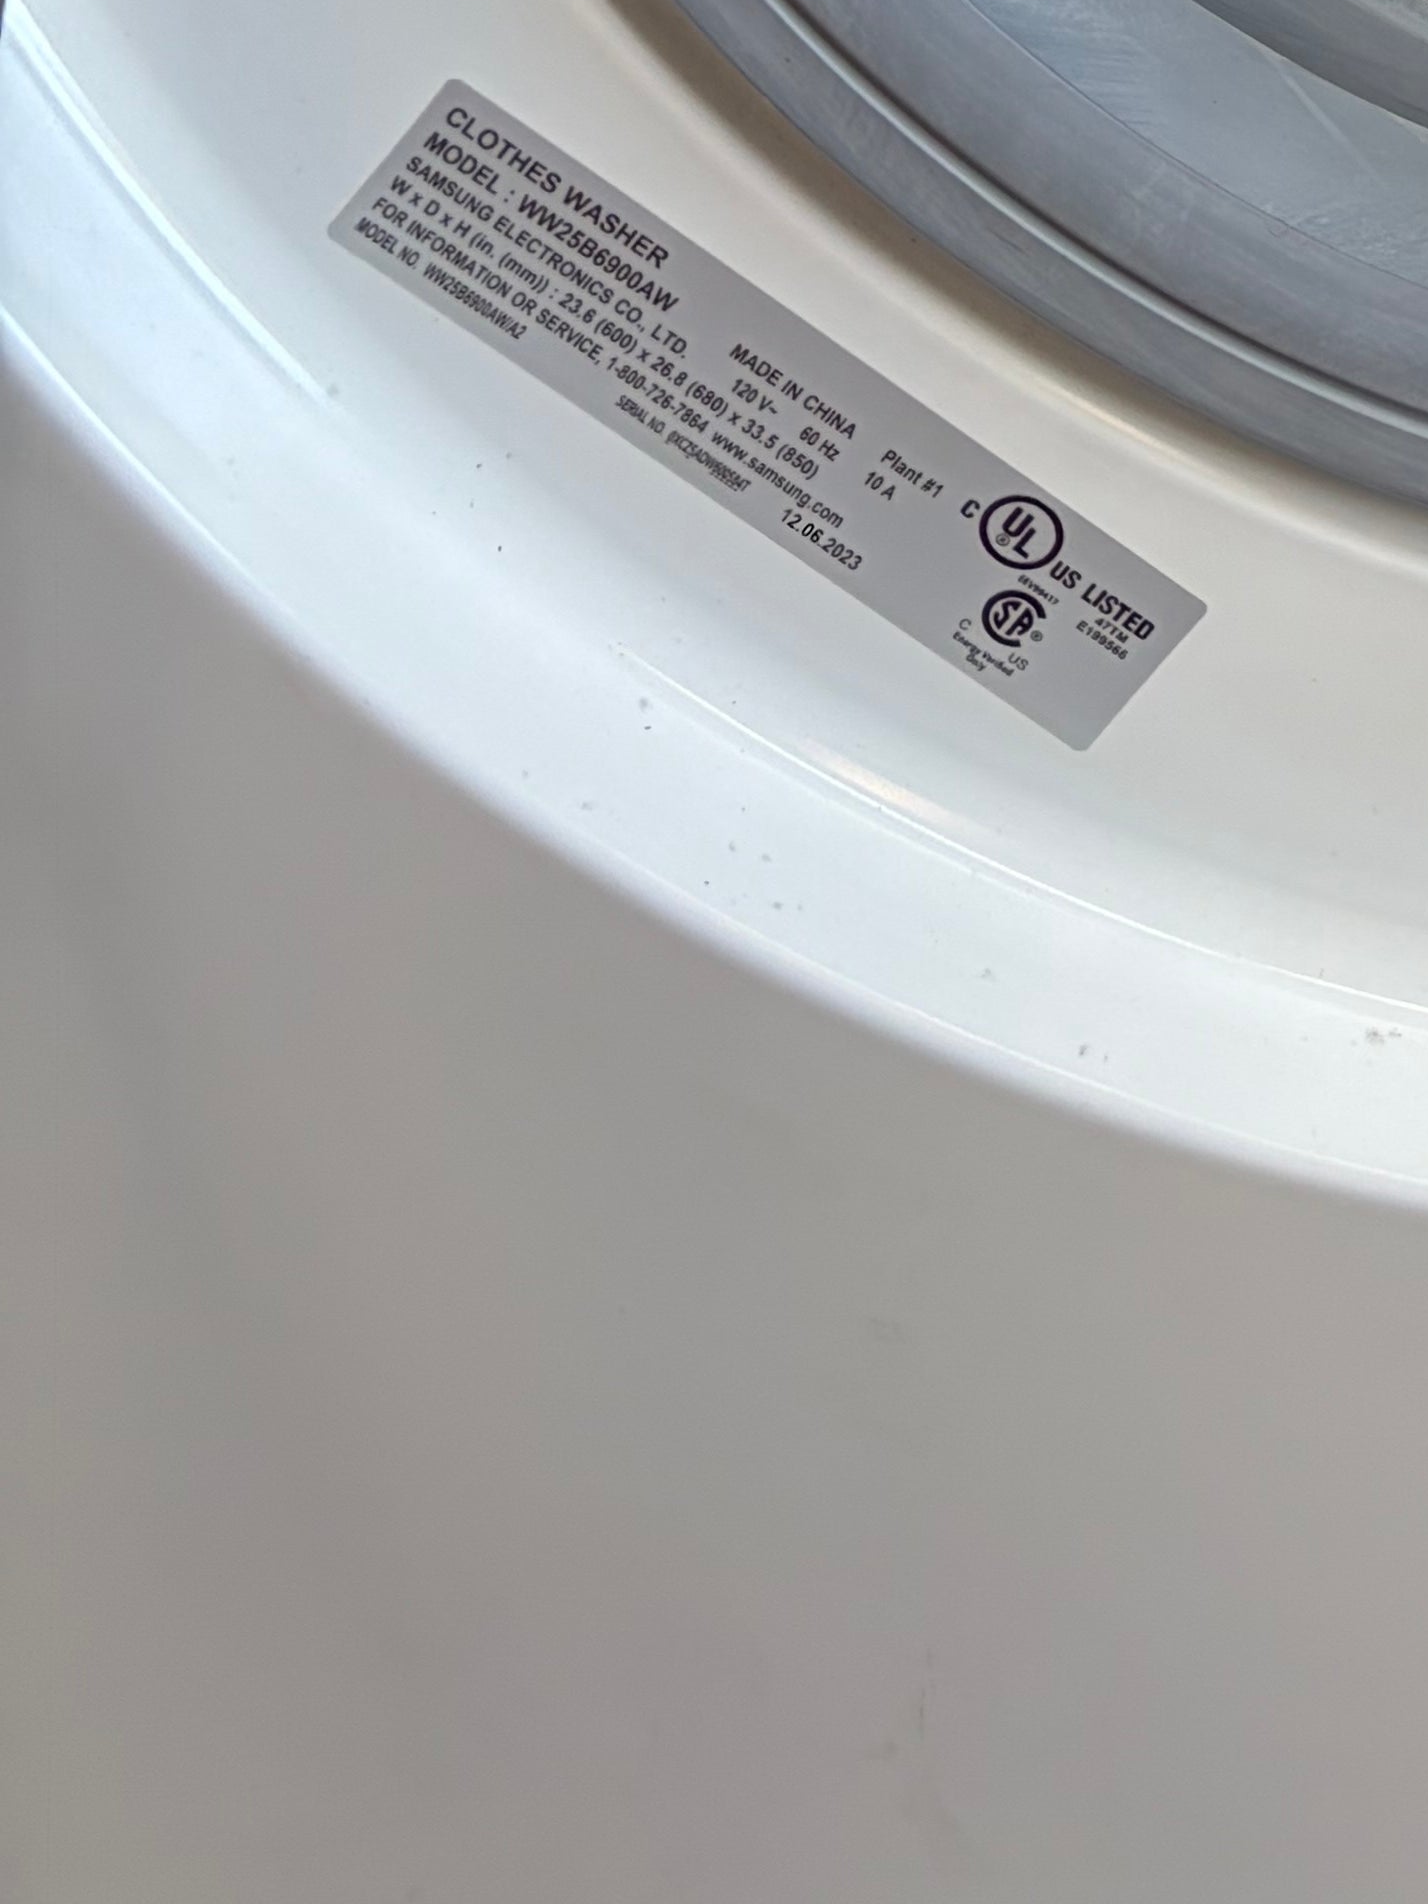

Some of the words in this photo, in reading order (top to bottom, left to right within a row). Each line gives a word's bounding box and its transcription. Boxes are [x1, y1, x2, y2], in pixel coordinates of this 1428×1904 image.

[423, 131, 500, 195] MODEL
[517, 193, 680, 312] WW25B6900AW
[446, 107, 562, 194] CLOTHES
[562, 185, 669, 270] WASHER
[354, 216, 398, 255] MODEL
[406, 156, 495, 222] SAMSUNG
[492, 215, 615, 305] ELECTRONICS
[650, 323, 688, 359] LTD.
[371, 196, 409, 229] FOR
[405, 219, 513, 299] INFORMATION
[510, 291, 538, 317] OR
[535, 307, 604, 366] SERVICE,
[606, 357, 710, 434] 1-800-726-7864
[711, 431, 844, 529] www.samsung.com
[390, 175, 413, 197] W
[423, 199, 441, 217] D
[452, 220, 472, 239] H
[468, 232, 494, 259] (in.
[557, 292, 597, 324] 23.6
[593, 318, 638, 355] (600)
[649, 355, 689, 388] 26.8
[684, 381, 729, 418] (680)
[741, 418, 780, 450] 33.5
[775, 443, 820, 481] (850)
[729, 343, 784, 387] MADE
[780, 379, 804, 401] IN
[802, 395, 856, 440] CHINA
[731, 378, 759, 404] 120
[799, 426, 821, 446] 60
[817, 439, 841, 462] Hz
[880, 449, 924, 486] Plant
[920, 478, 944, 498] #1
[864, 471, 885, 491] 10
[880, 484, 896, 501] A
[781, 509, 863, 570] 12.06.2023
[1049, 560, 1082, 590] US
[1080, 583, 1155, 641] LISTED
[1007, 652, 1029, 671] US
